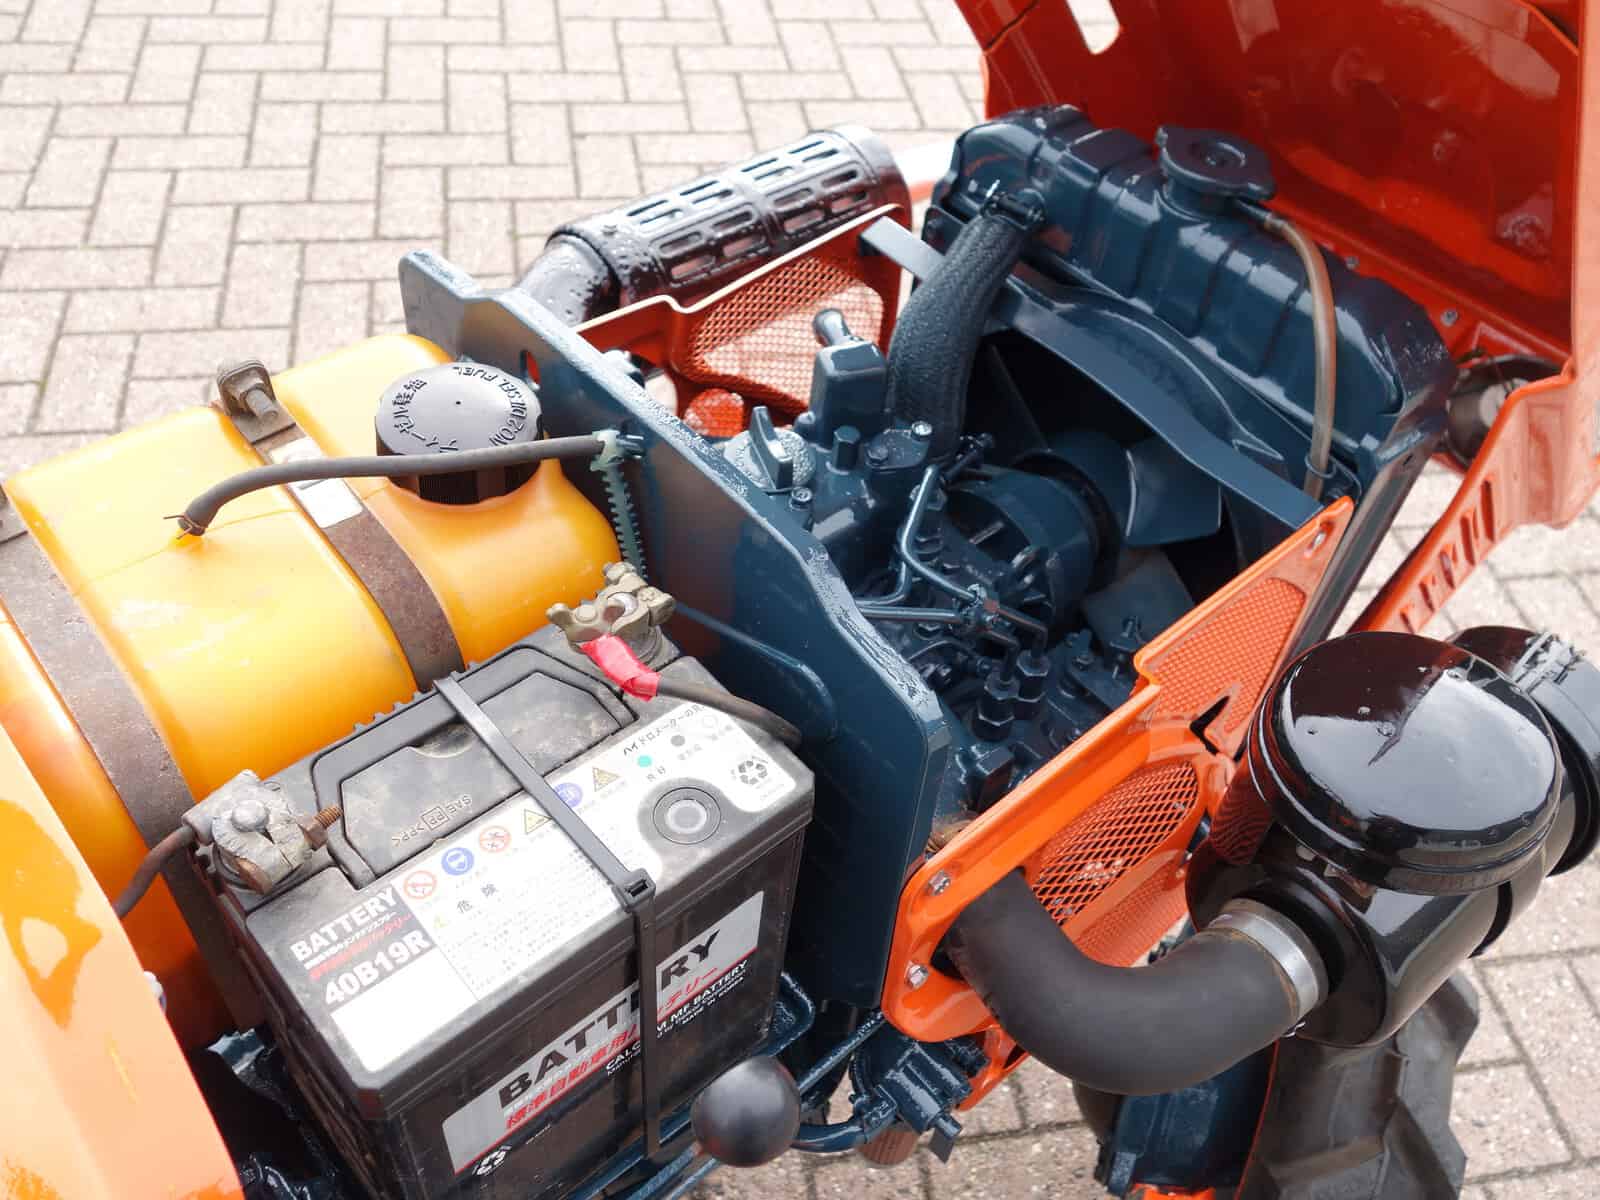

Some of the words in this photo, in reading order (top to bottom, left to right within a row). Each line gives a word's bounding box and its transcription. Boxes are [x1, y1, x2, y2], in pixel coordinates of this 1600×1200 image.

[452, 366, 498, 382] FUEL
[290, 887, 397, 961] BATTERY
[325, 929, 431, 1004] 40B19R
[693, 959, 748, 1006] BATTERY
